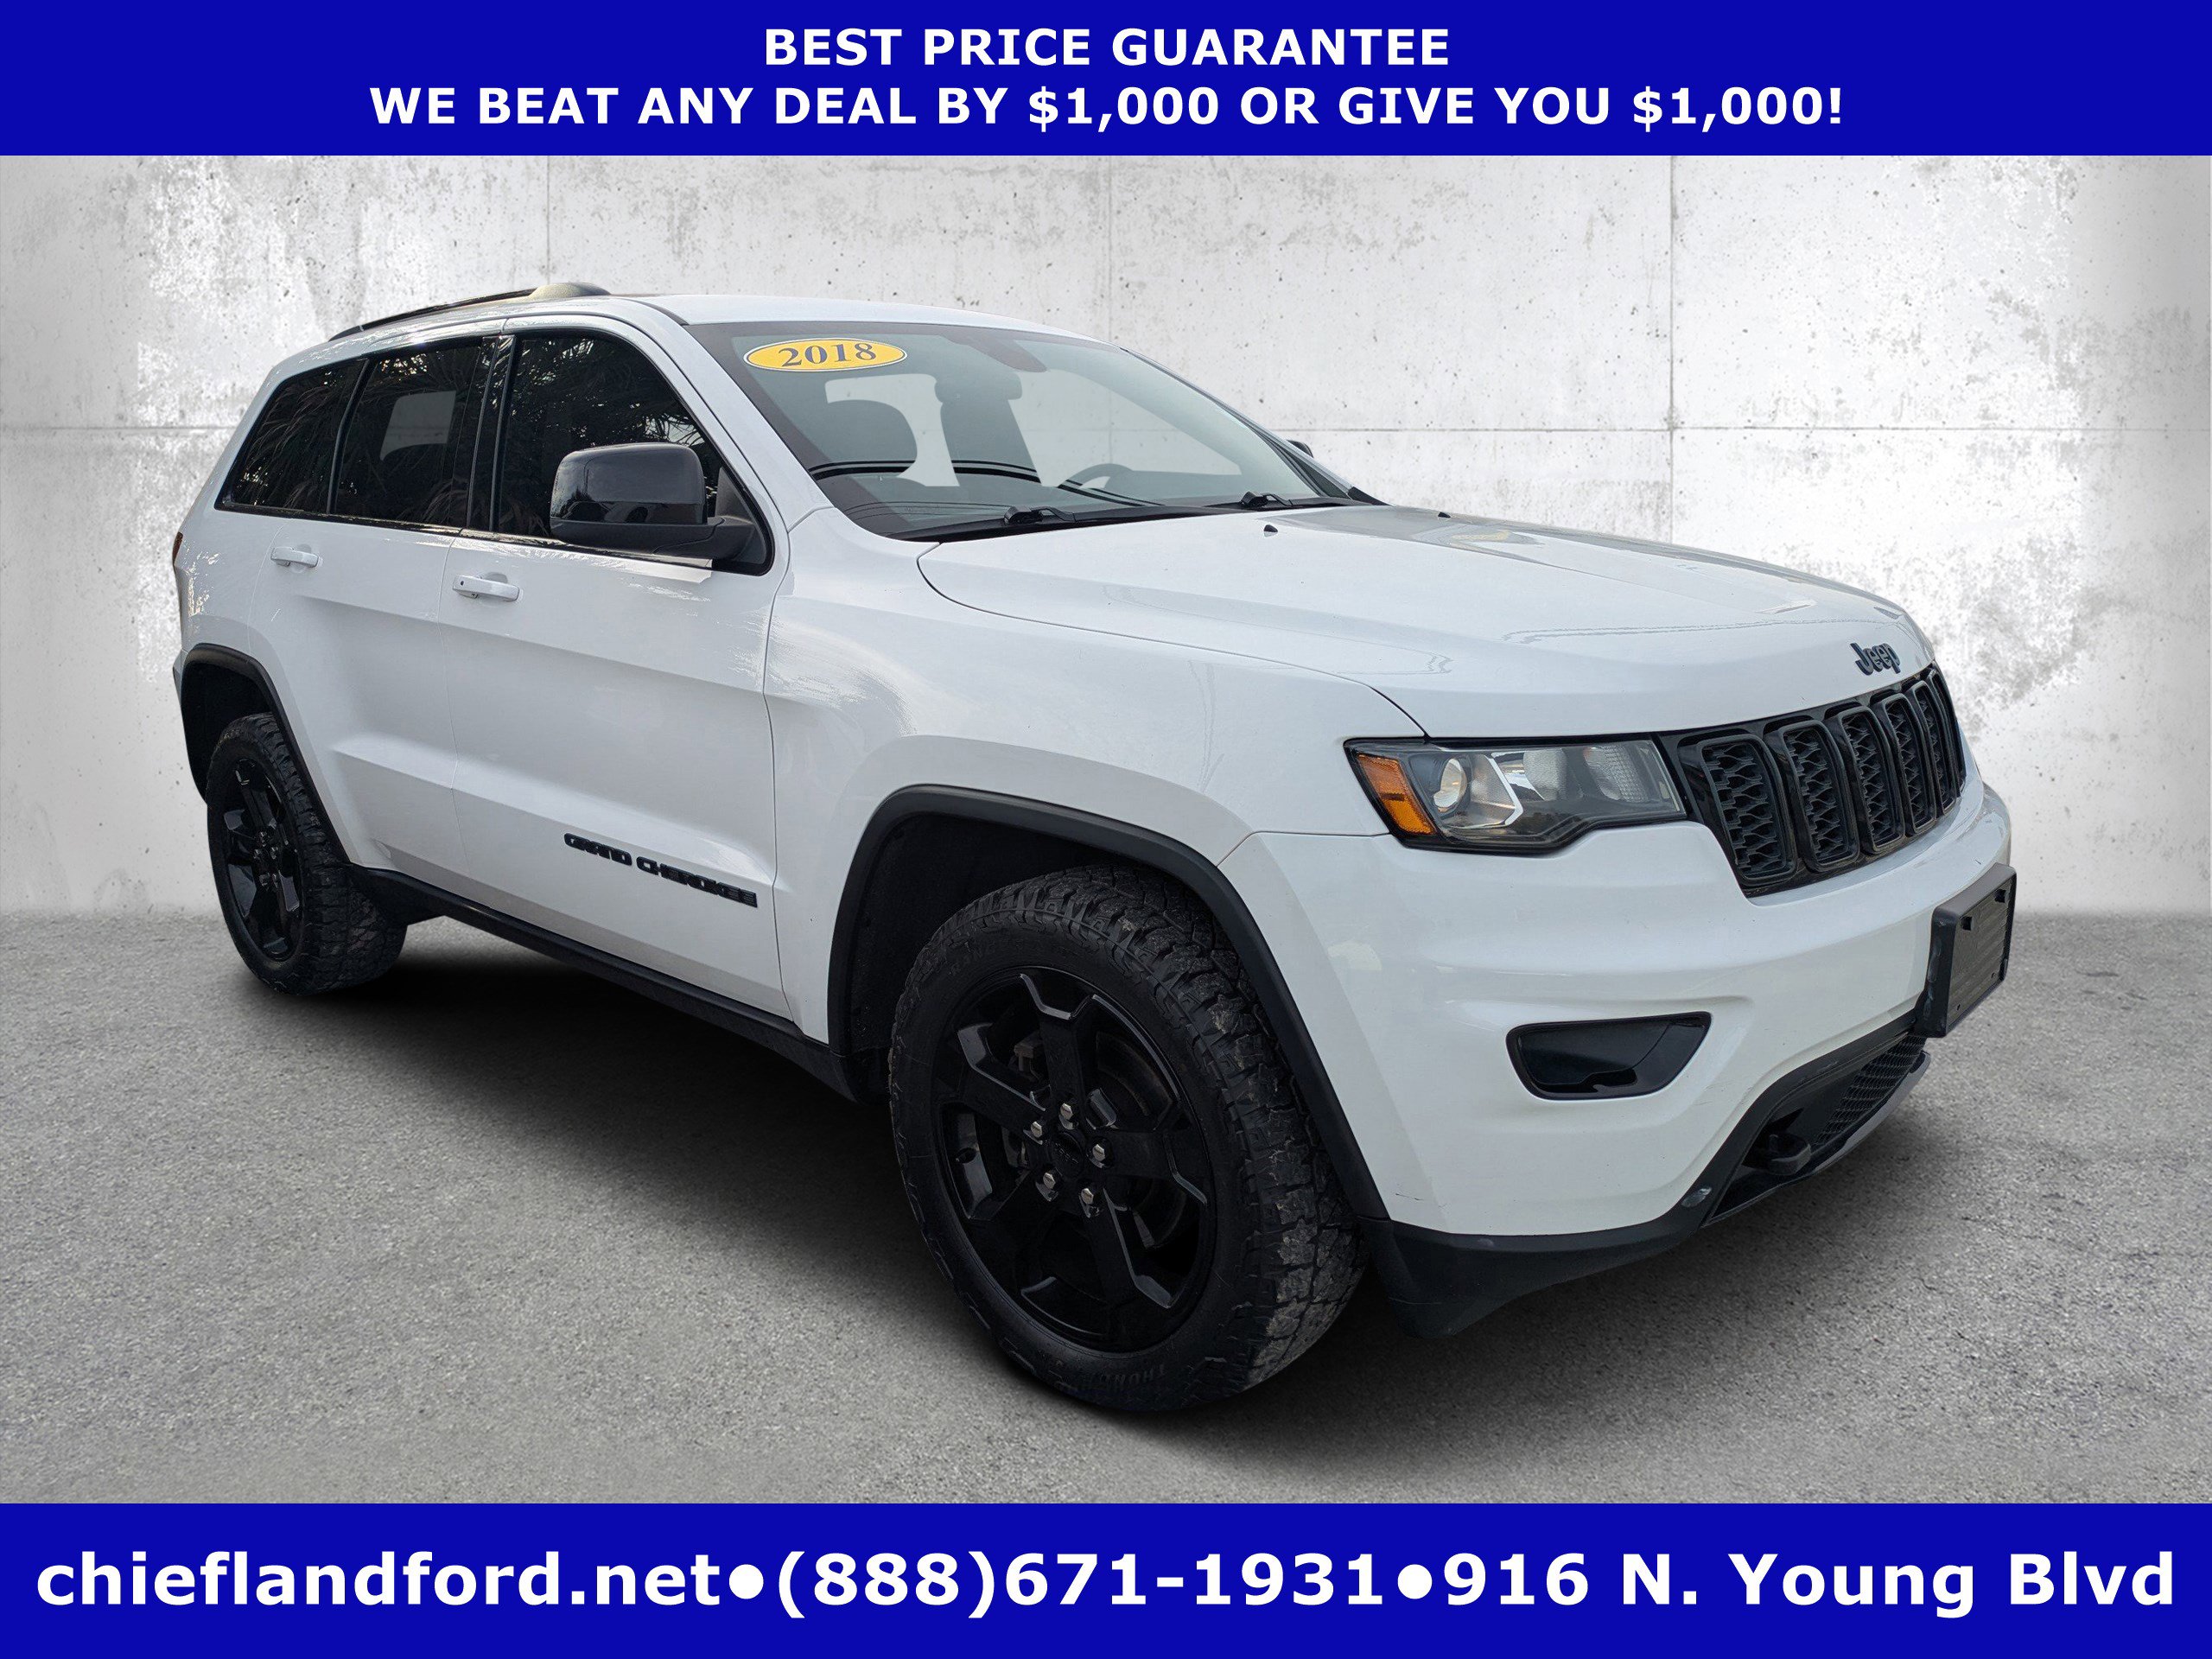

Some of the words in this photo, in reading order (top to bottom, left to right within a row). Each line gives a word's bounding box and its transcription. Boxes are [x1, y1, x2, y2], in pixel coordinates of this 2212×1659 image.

[778, 342, 877, 368] 2018
[1849, 642, 1901, 676] Jeep
[563, 832, 633, 867] GRAND
[636, 855, 759, 908] CHEROKEE
